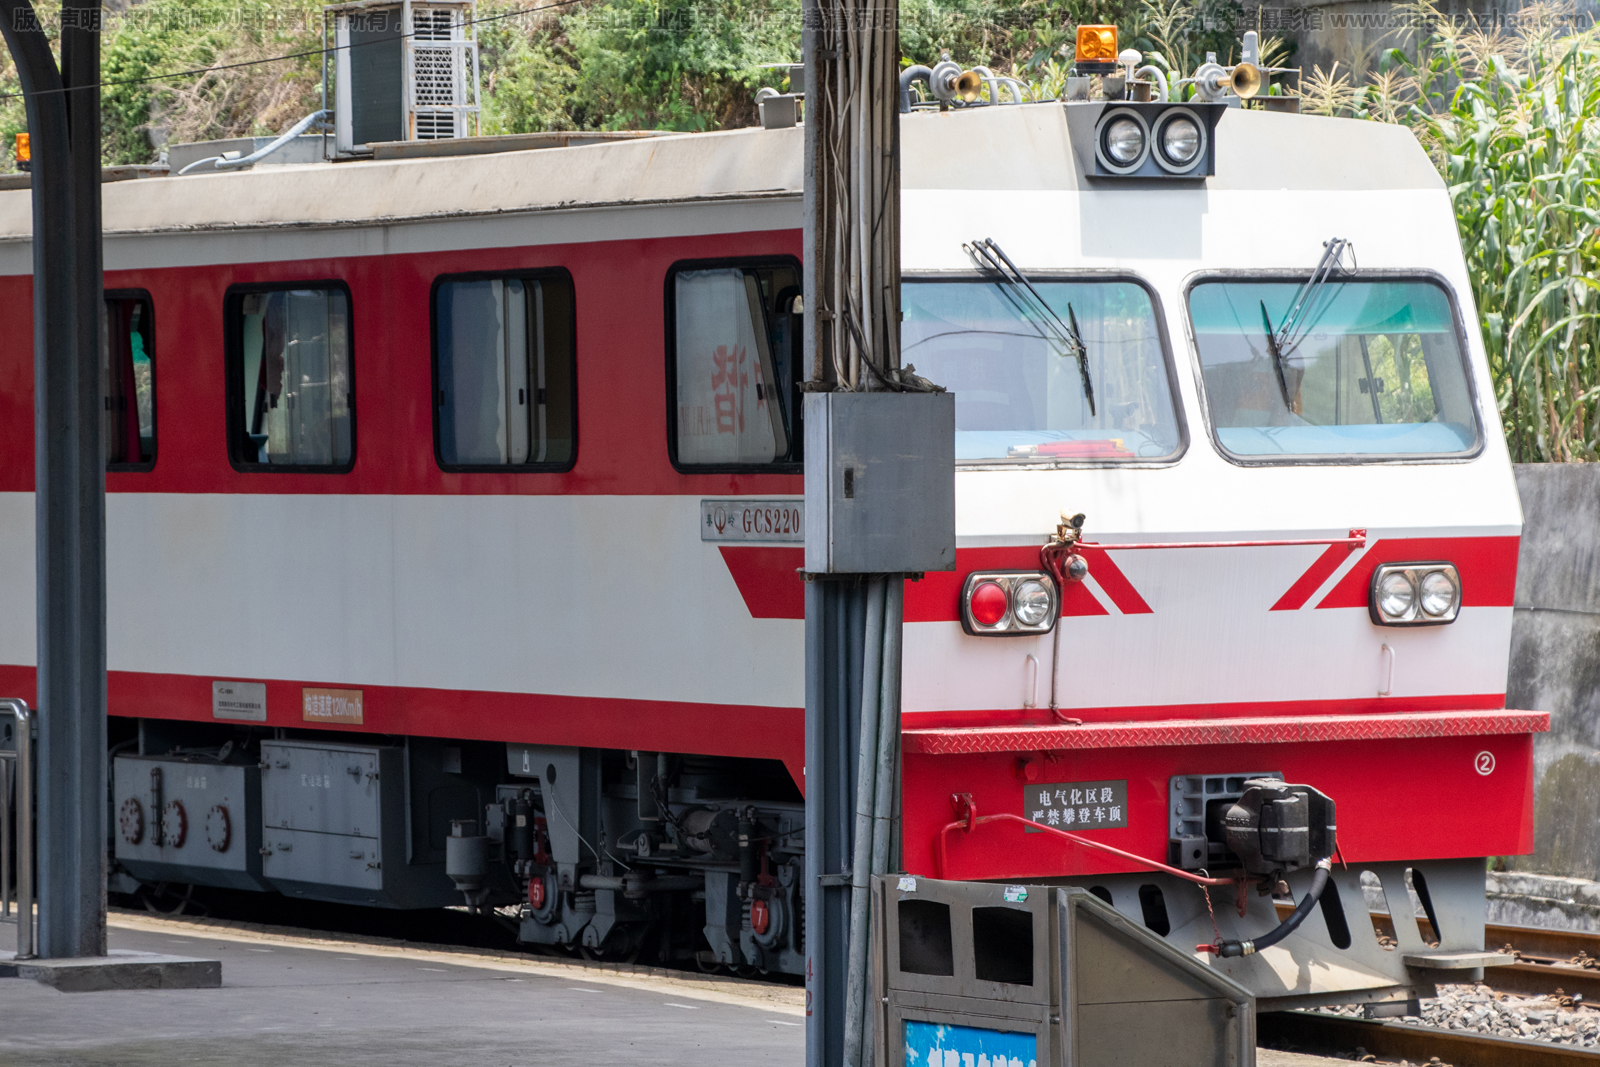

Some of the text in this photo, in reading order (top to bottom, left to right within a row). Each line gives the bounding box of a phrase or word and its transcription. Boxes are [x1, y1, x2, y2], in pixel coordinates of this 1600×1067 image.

[742, 508, 800, 534] GCS220
[1039, 786, 1114, 807] 电气化区段
[1032, 805, 1122, 826] 严禁攀登车顶
[533, 883, 540, 902] 5
[756, 907, 763, 926] 7
